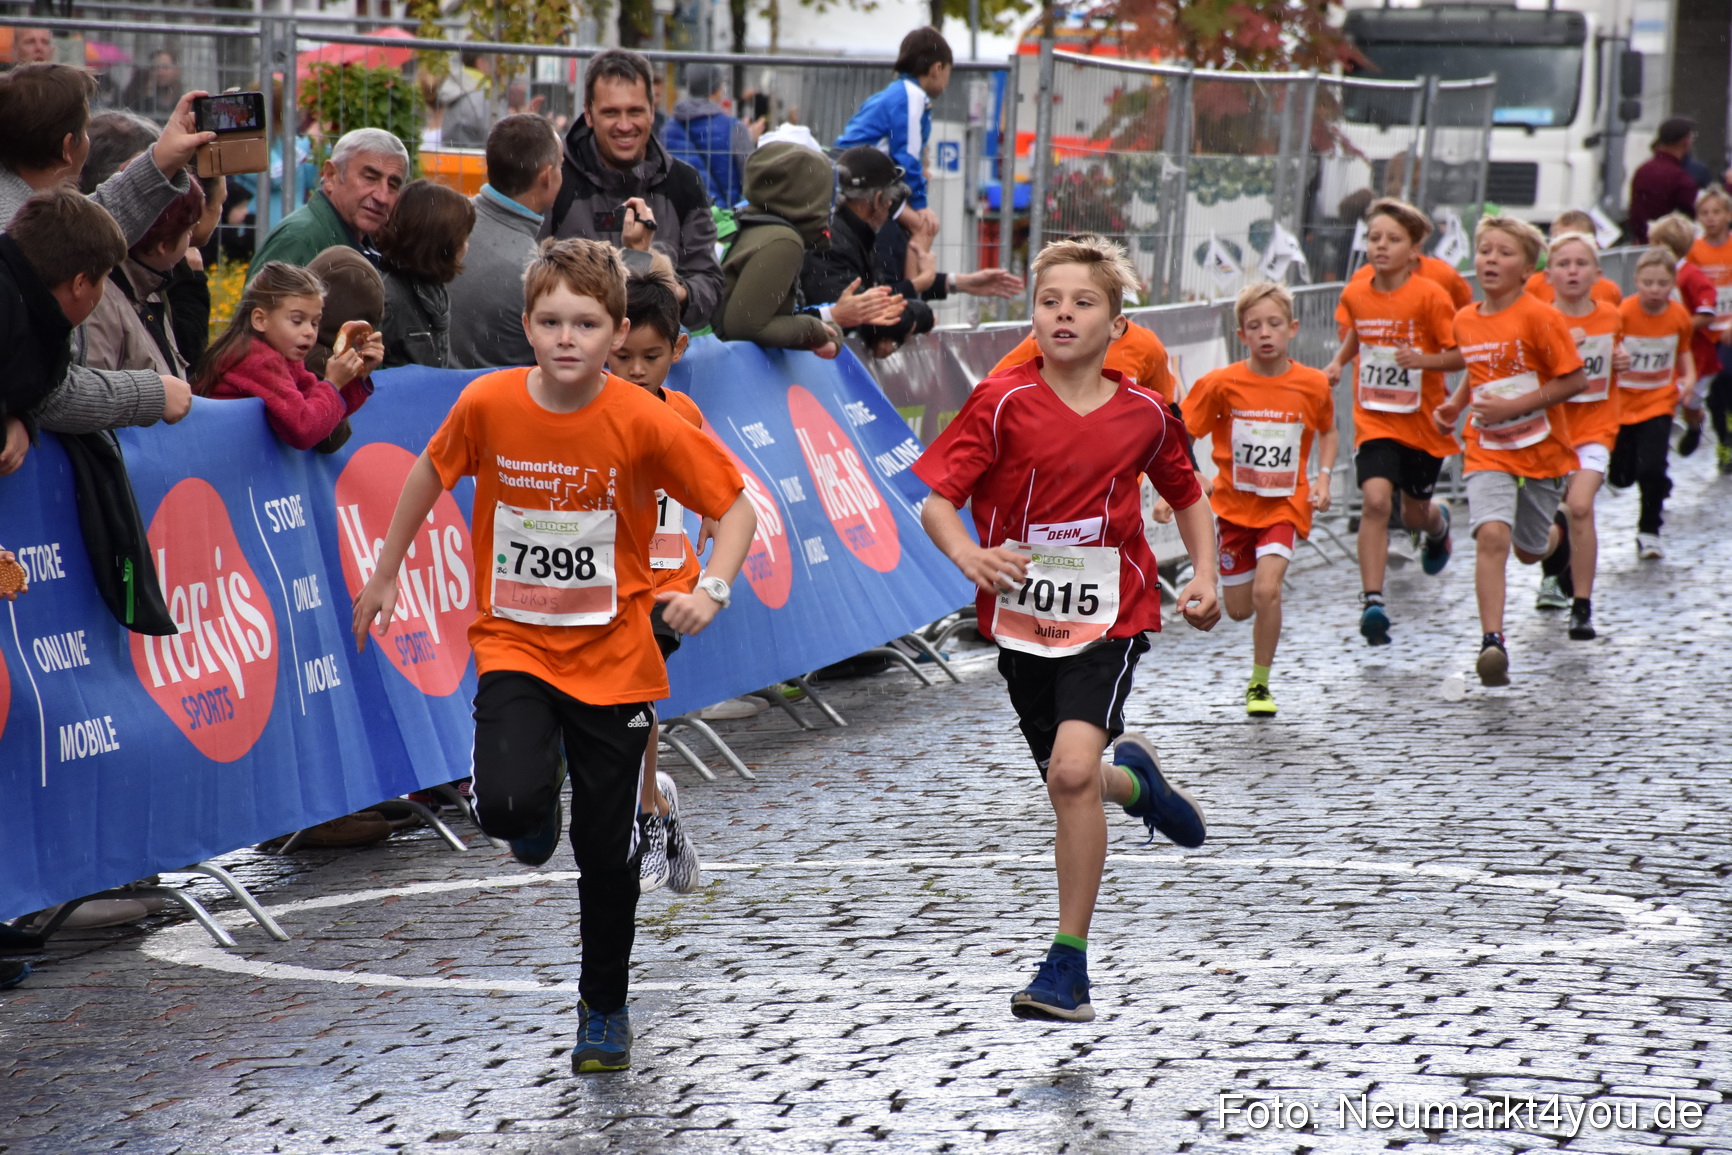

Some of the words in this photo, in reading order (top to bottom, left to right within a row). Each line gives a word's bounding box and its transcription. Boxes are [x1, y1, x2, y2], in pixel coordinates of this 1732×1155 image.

[1366, 365, 1410, 387] 7124
[1584, 356, 1603, 376] 90
[496, 454, 580, 477] Neumarkter
[1242, 444, 1292, 468] 7234
[498, 471, 562, 494] Stadtlauf
[264, 494, 306, 533] STORE
[535, 520, 580, 533] BOCK
[1047, 527, 1082, 541] DEHN
[18, 543, 66, 584] STORE
[511, 541, 597, 581] 7398
[1043, 555, 1085, 567] BOCK
[511, 583, 560, 610] Lukas
[1013, 577, 1099, 617] 7015
[1035, 624, 1070, 640] Julian
[33, 630, 91, 673] ONLINE
[395, 631, 437, 667] SPORTS
[305, 654, 341, 695] MOBILE
[181, 686, 235, 731] SPORTS
[59, 715, 120, 763] MOBILE
